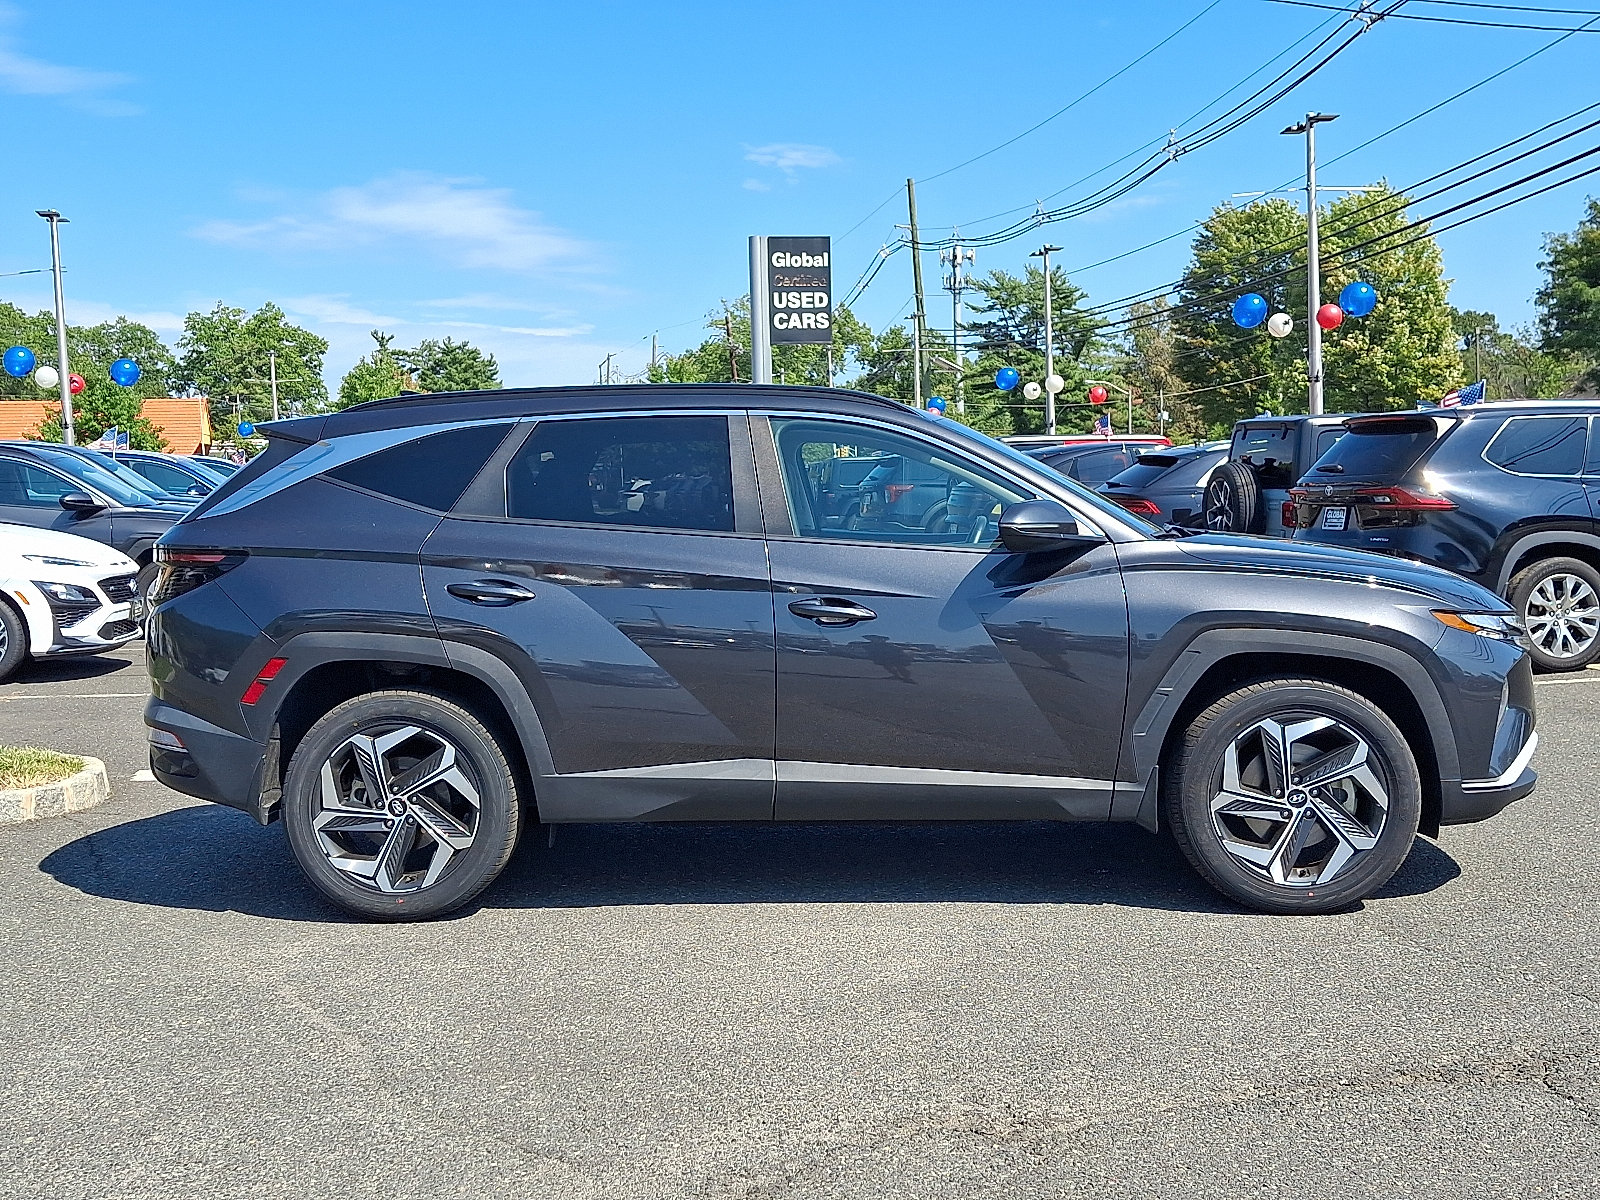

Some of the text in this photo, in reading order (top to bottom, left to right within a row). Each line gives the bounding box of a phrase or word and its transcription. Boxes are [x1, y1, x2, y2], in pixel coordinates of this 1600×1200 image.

[771, 252, 828, 268] Global
[773, 274, 827, 287] Certified
[773, 291, 829, 309] USED
[773, 312, 830, 329] CARS
[1327, 510, 1345, 519] GLOBAL
